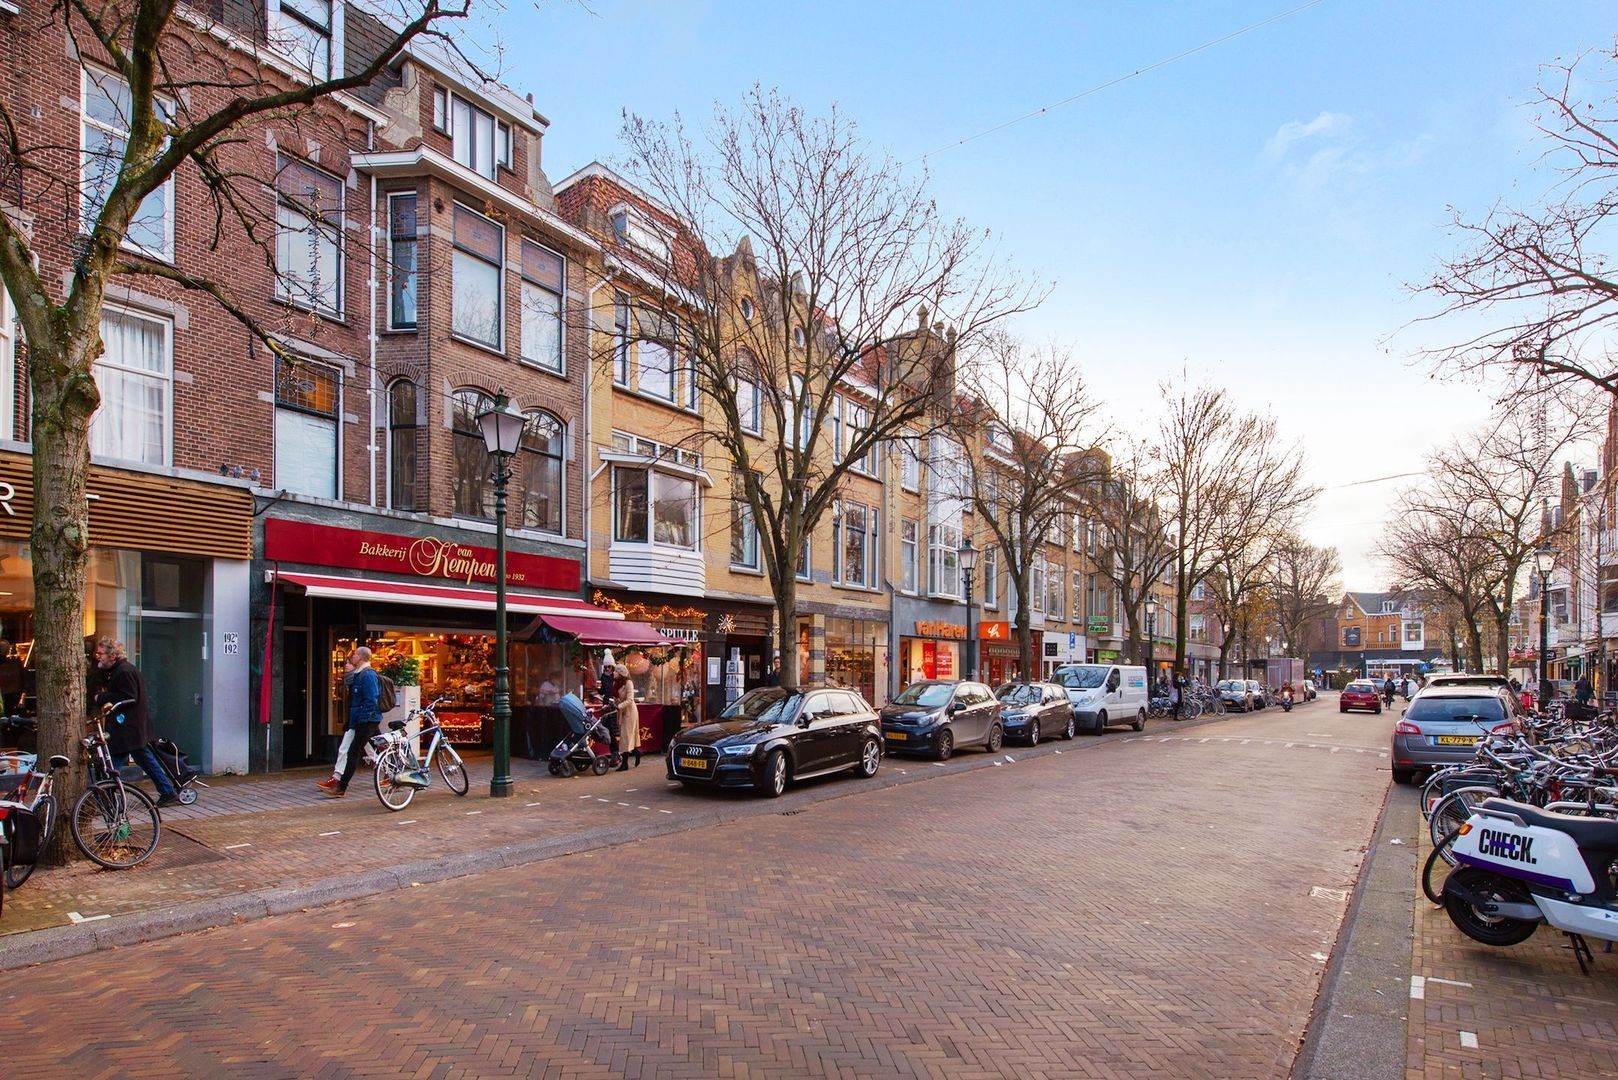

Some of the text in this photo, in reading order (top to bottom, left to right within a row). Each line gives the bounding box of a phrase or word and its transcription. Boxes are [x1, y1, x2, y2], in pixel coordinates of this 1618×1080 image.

[359, 536, 497, 586] Bakkerij van Kempen
[224, 644, 237, 654] 192
[1478, 828, 1537, 865] CHECK.
